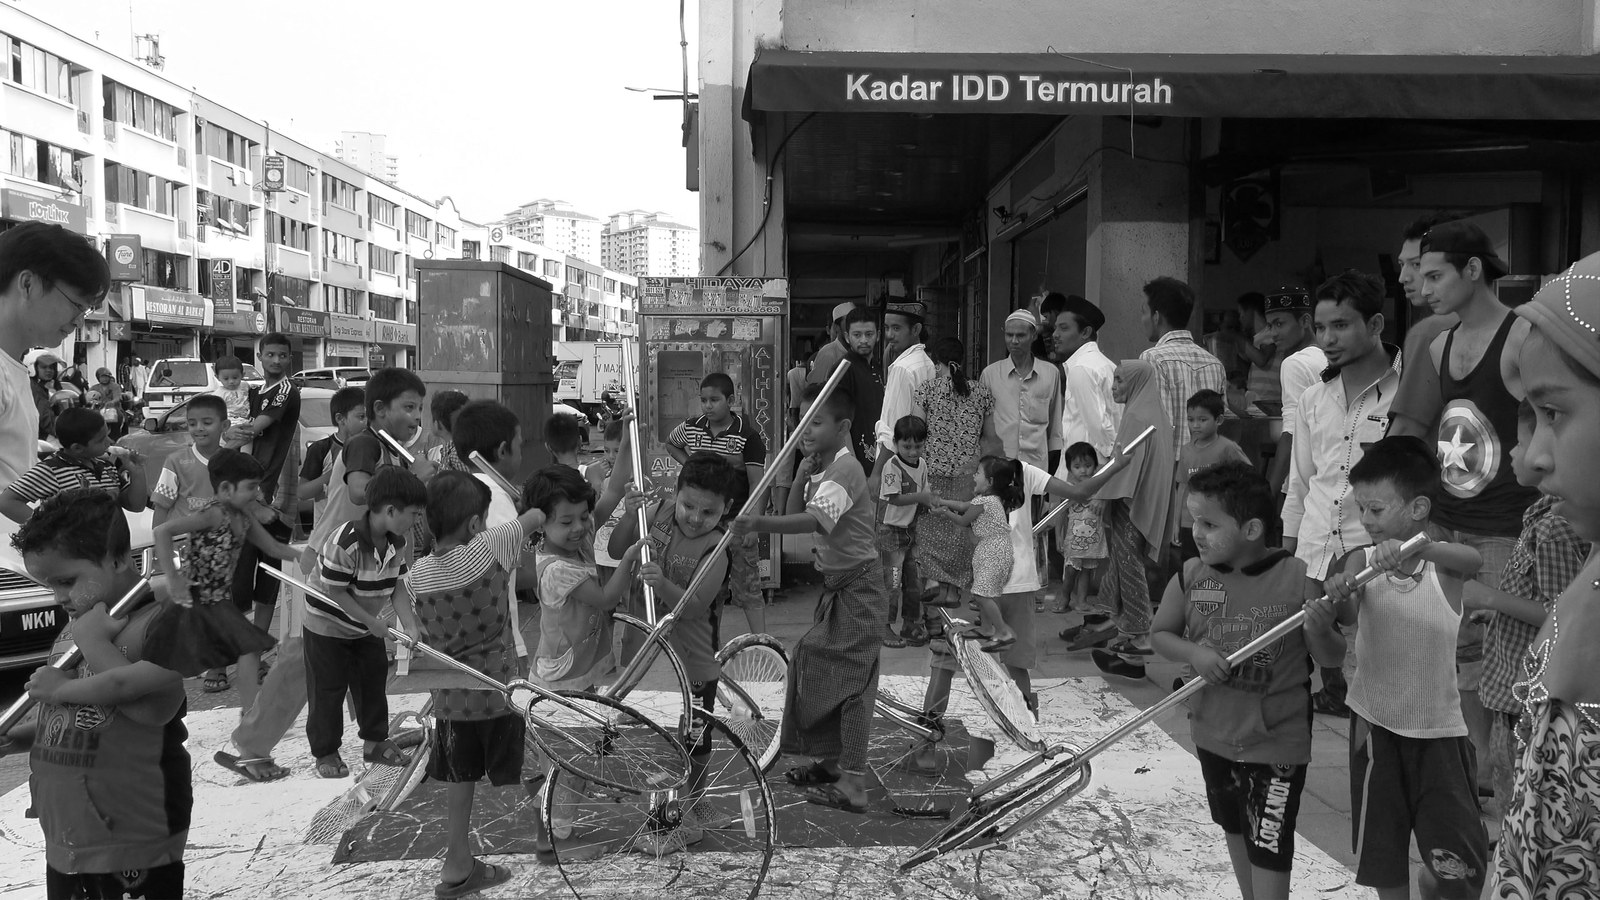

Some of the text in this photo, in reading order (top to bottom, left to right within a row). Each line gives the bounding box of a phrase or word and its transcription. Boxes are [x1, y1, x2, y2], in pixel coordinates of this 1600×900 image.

[846, 74, 1172, 104] Kadar IDD Termurah
[212, 260, 231, 274] 4D
[21, 610, 56, 631] WKM
[1264, 777, 1291, 820] JONY
[1258, 817, 1282, 854] BOY
